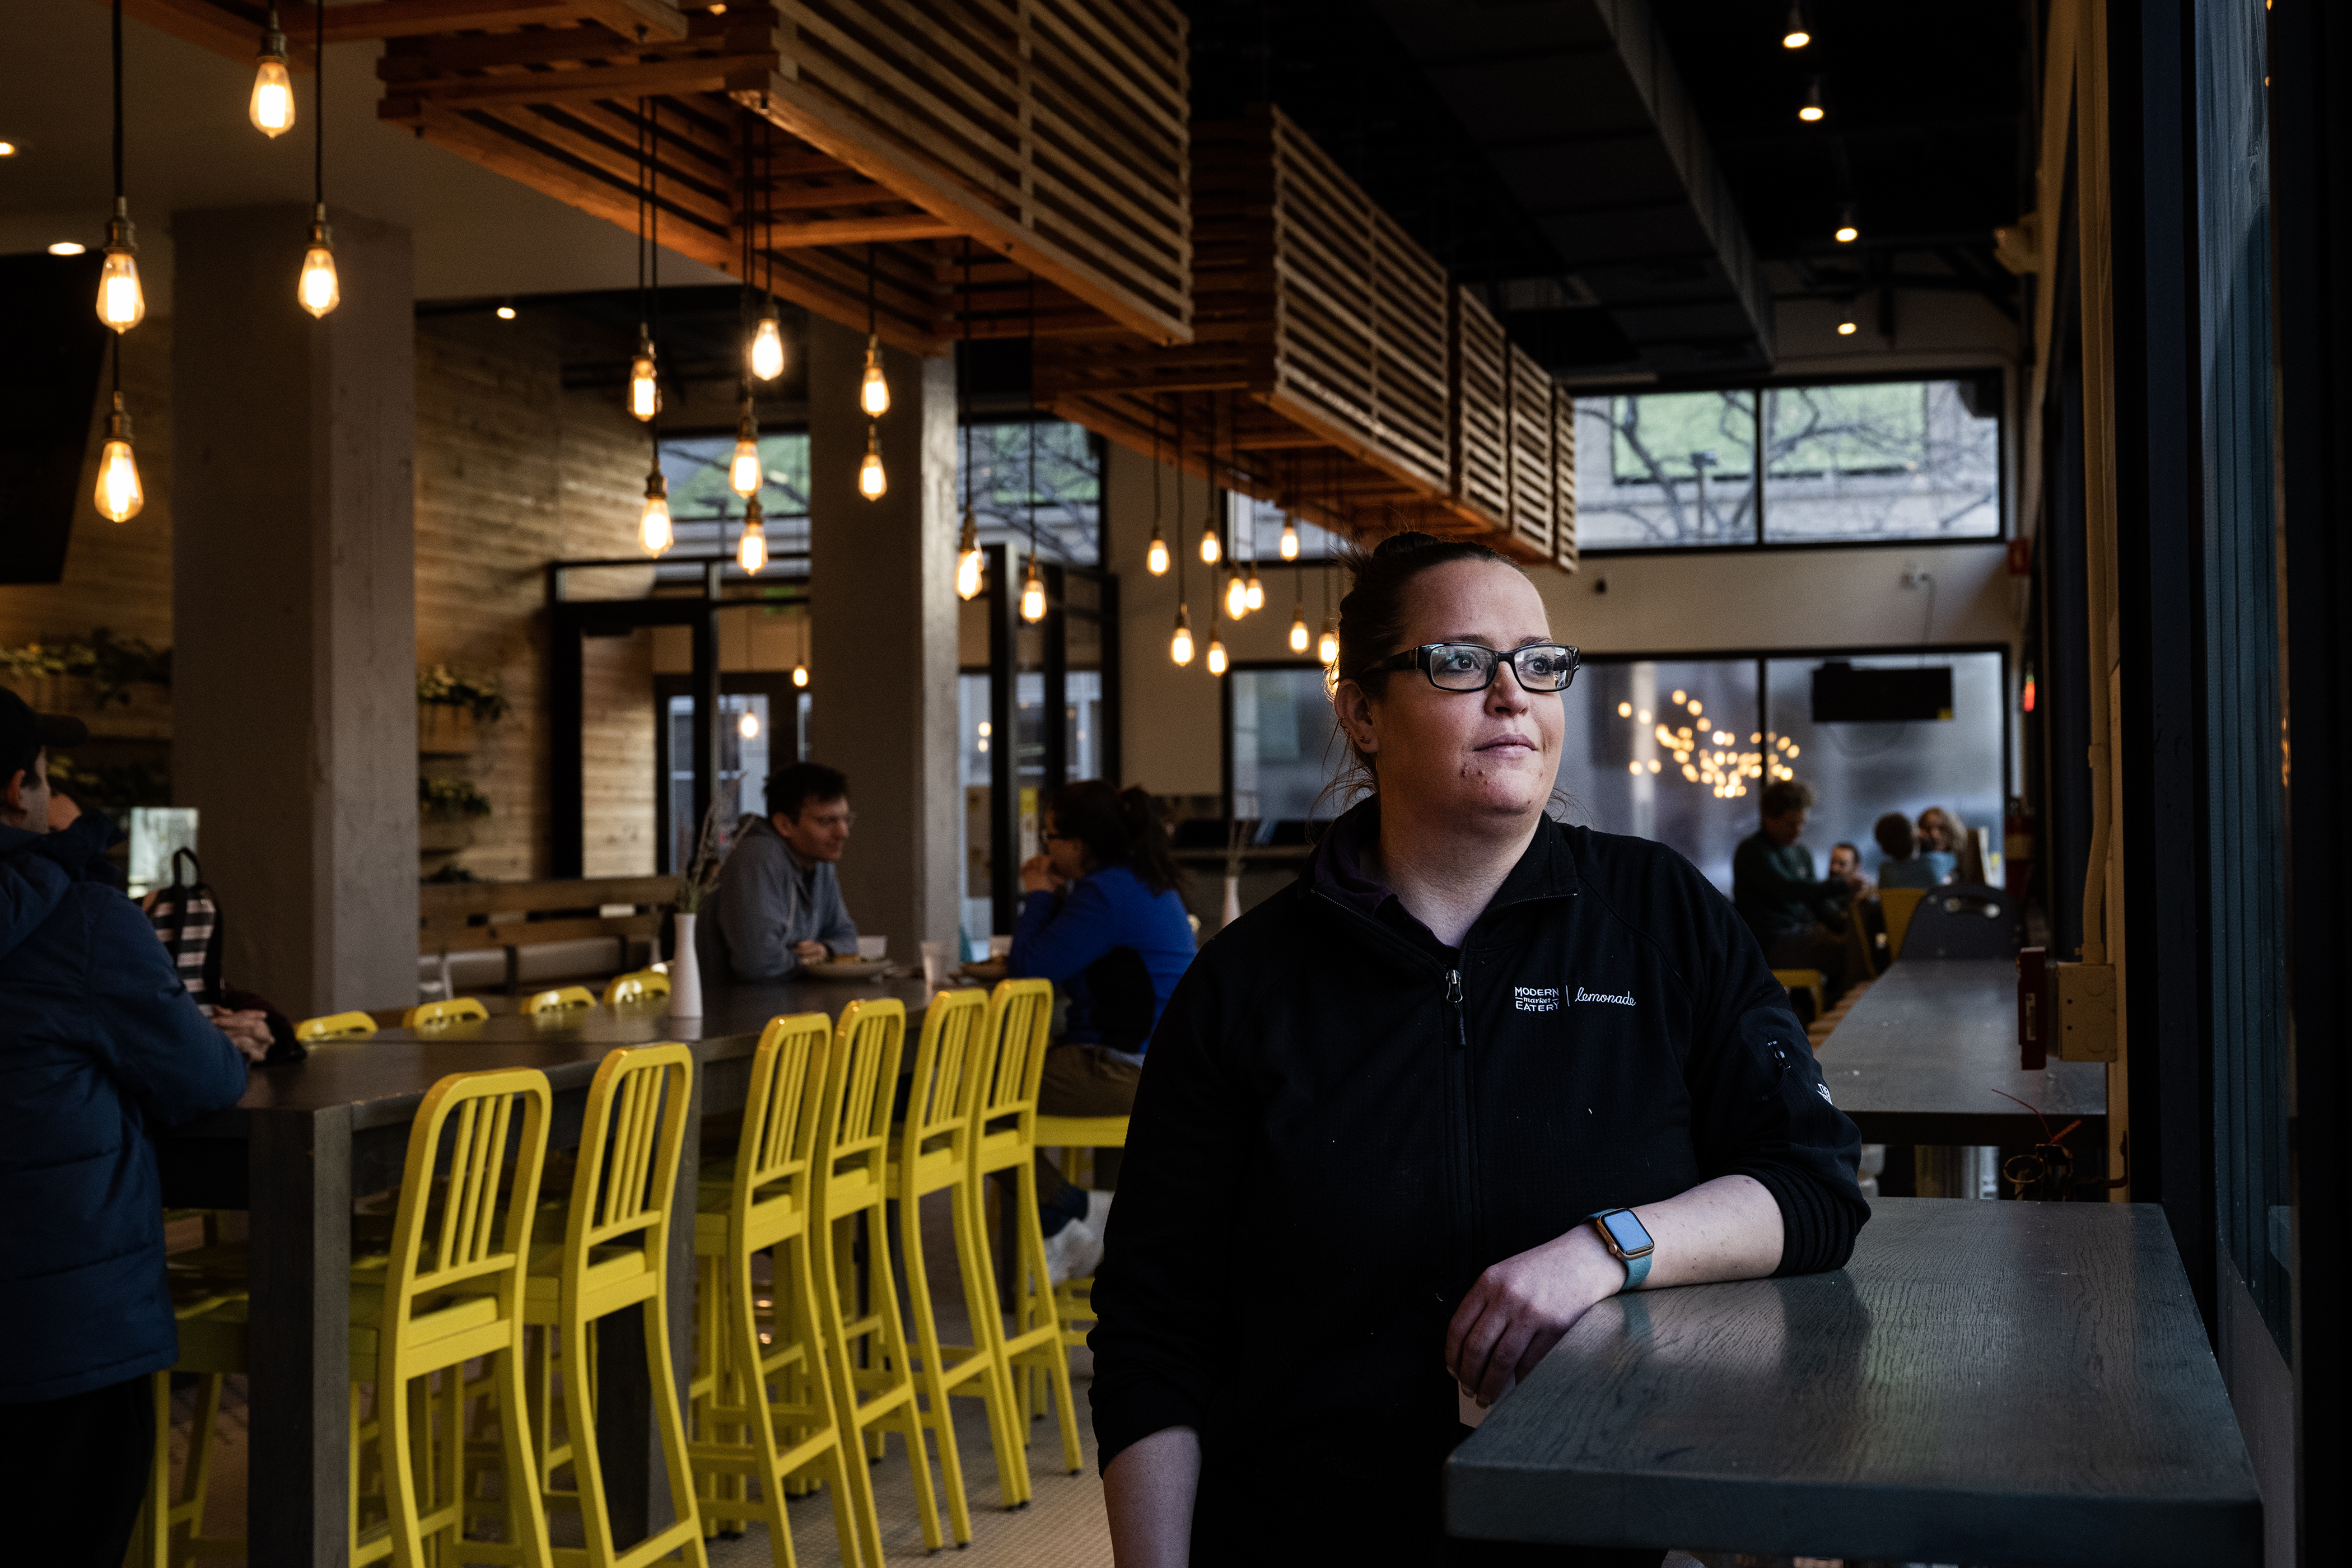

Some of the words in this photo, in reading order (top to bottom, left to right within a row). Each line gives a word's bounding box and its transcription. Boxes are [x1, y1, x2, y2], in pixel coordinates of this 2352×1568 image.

[1514, 986, 1560, 998] MODERN
[1574, 987, 1636, 1006] lemonade
[1515, 1000, 1560, 1012] EATERY
